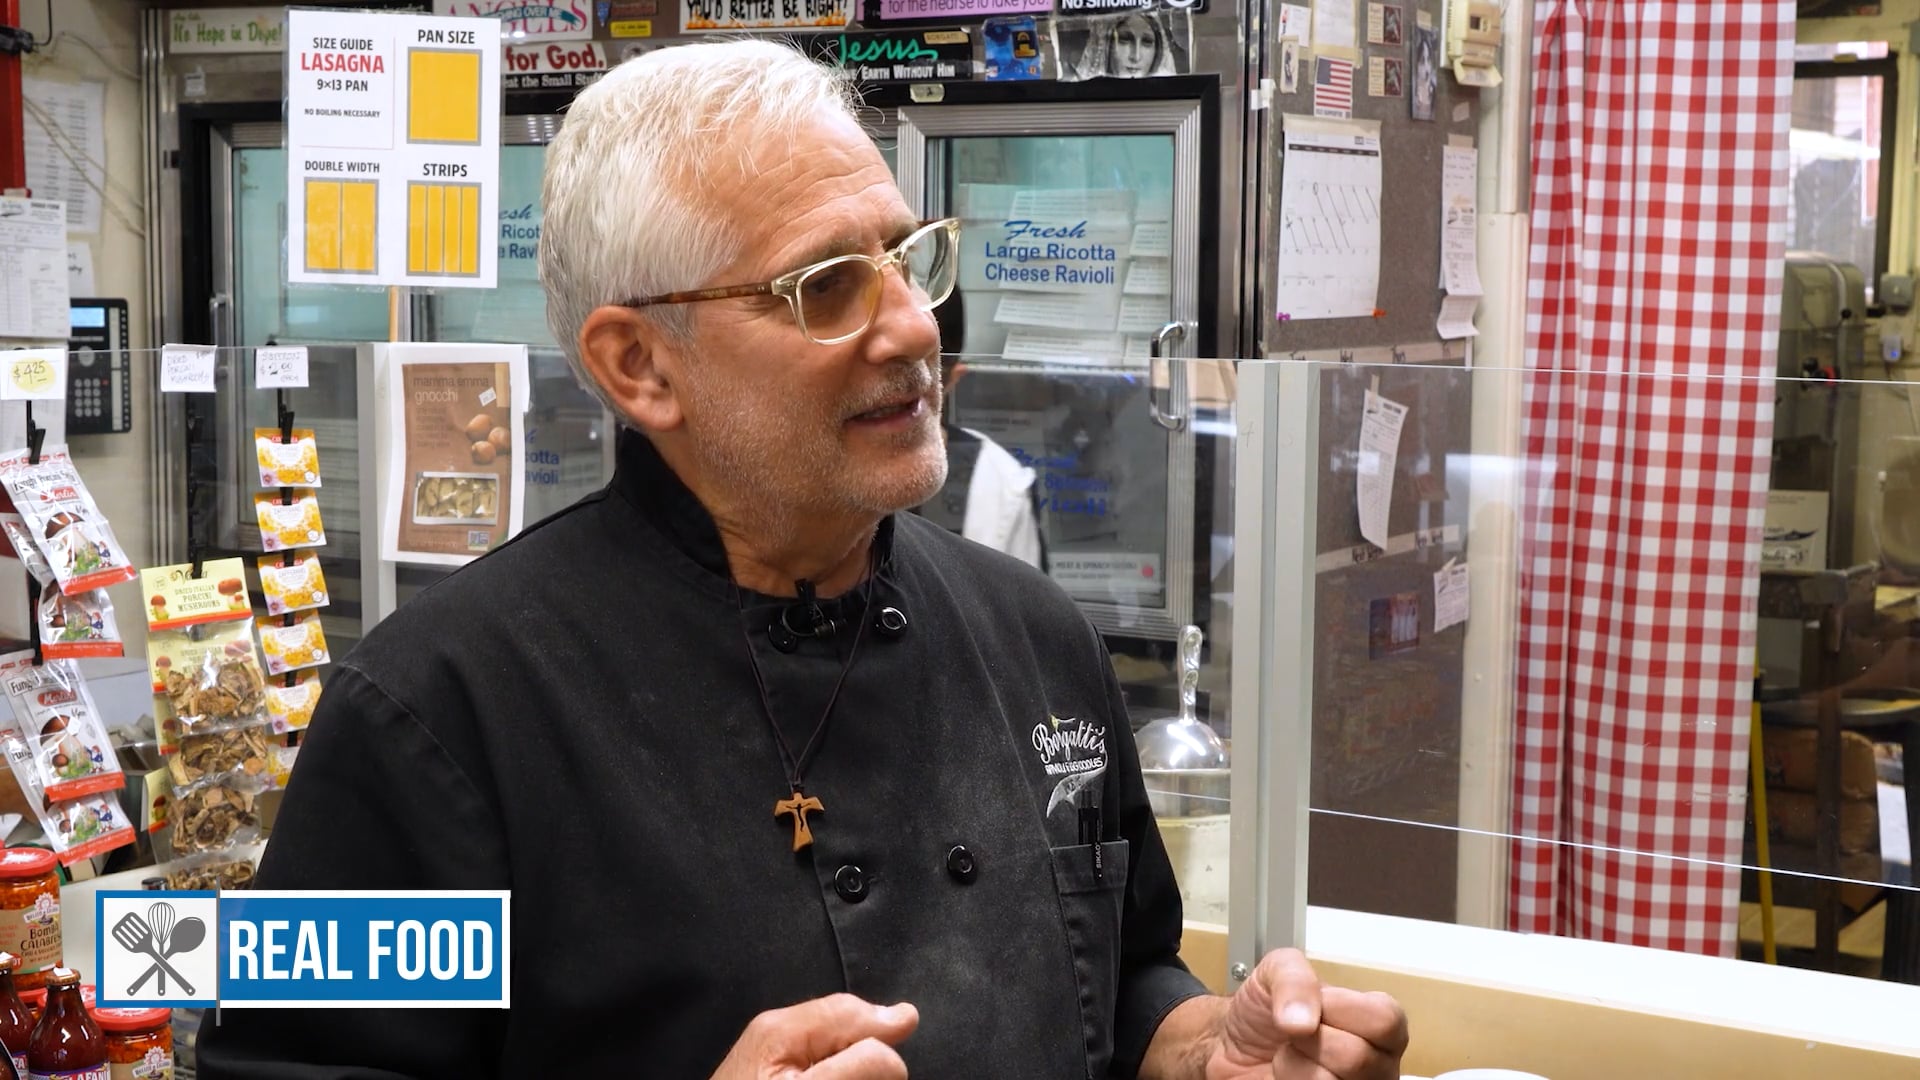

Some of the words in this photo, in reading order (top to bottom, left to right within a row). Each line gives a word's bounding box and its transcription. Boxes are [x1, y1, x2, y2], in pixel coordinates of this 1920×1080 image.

[730, 0, 774, 18] BETTER
[783, 0, 799, 18] BE
[1062, 0, 1081, 9] No
[1083, 0, 1152, 9] Smoking
[197, 22, 225, 46] Hope
[231, 24, 242, 41] in
[418, 29, 443, 43] PAN
[448, 31, 475, 44] SIZE
[313, 37, 337, 49] SIZE
[340, 38, 373, 51] GUIDE
[838, 34, 938, 64] Jesus
[301, 53, 385, 73] LASAGNA
[506, 45, 539, 71] for
[546, 43, 604, 70] God.
[345, 80, 368, 92] PAN
[522, 76, 539, 87] the
[541, 74, 572, 86] Small
[315, 109, 342, 117] BOILING
[343, 110, 380, 118] NECESSARY
[305, 160, 343, 172] DOUBLE
[347, 161, 380, 173] WIDTH
[423, 163, 468, 177] STRIPS
[1004, 220, 1088, 241] Fresh
[985, 242, 1041, 262] Large
[1047, 244, 1116, 261] Ricotta
[985, 263, 1050, 281] Cheese
[1055, 265, 1115, 284] Ravioli
[413, 376, 455, 386] mamma
[457, 376, 489, 386] emma
[415, 390, 458, 405] gnocchi
[1032, 721, 1106, 763] Borgatti's
